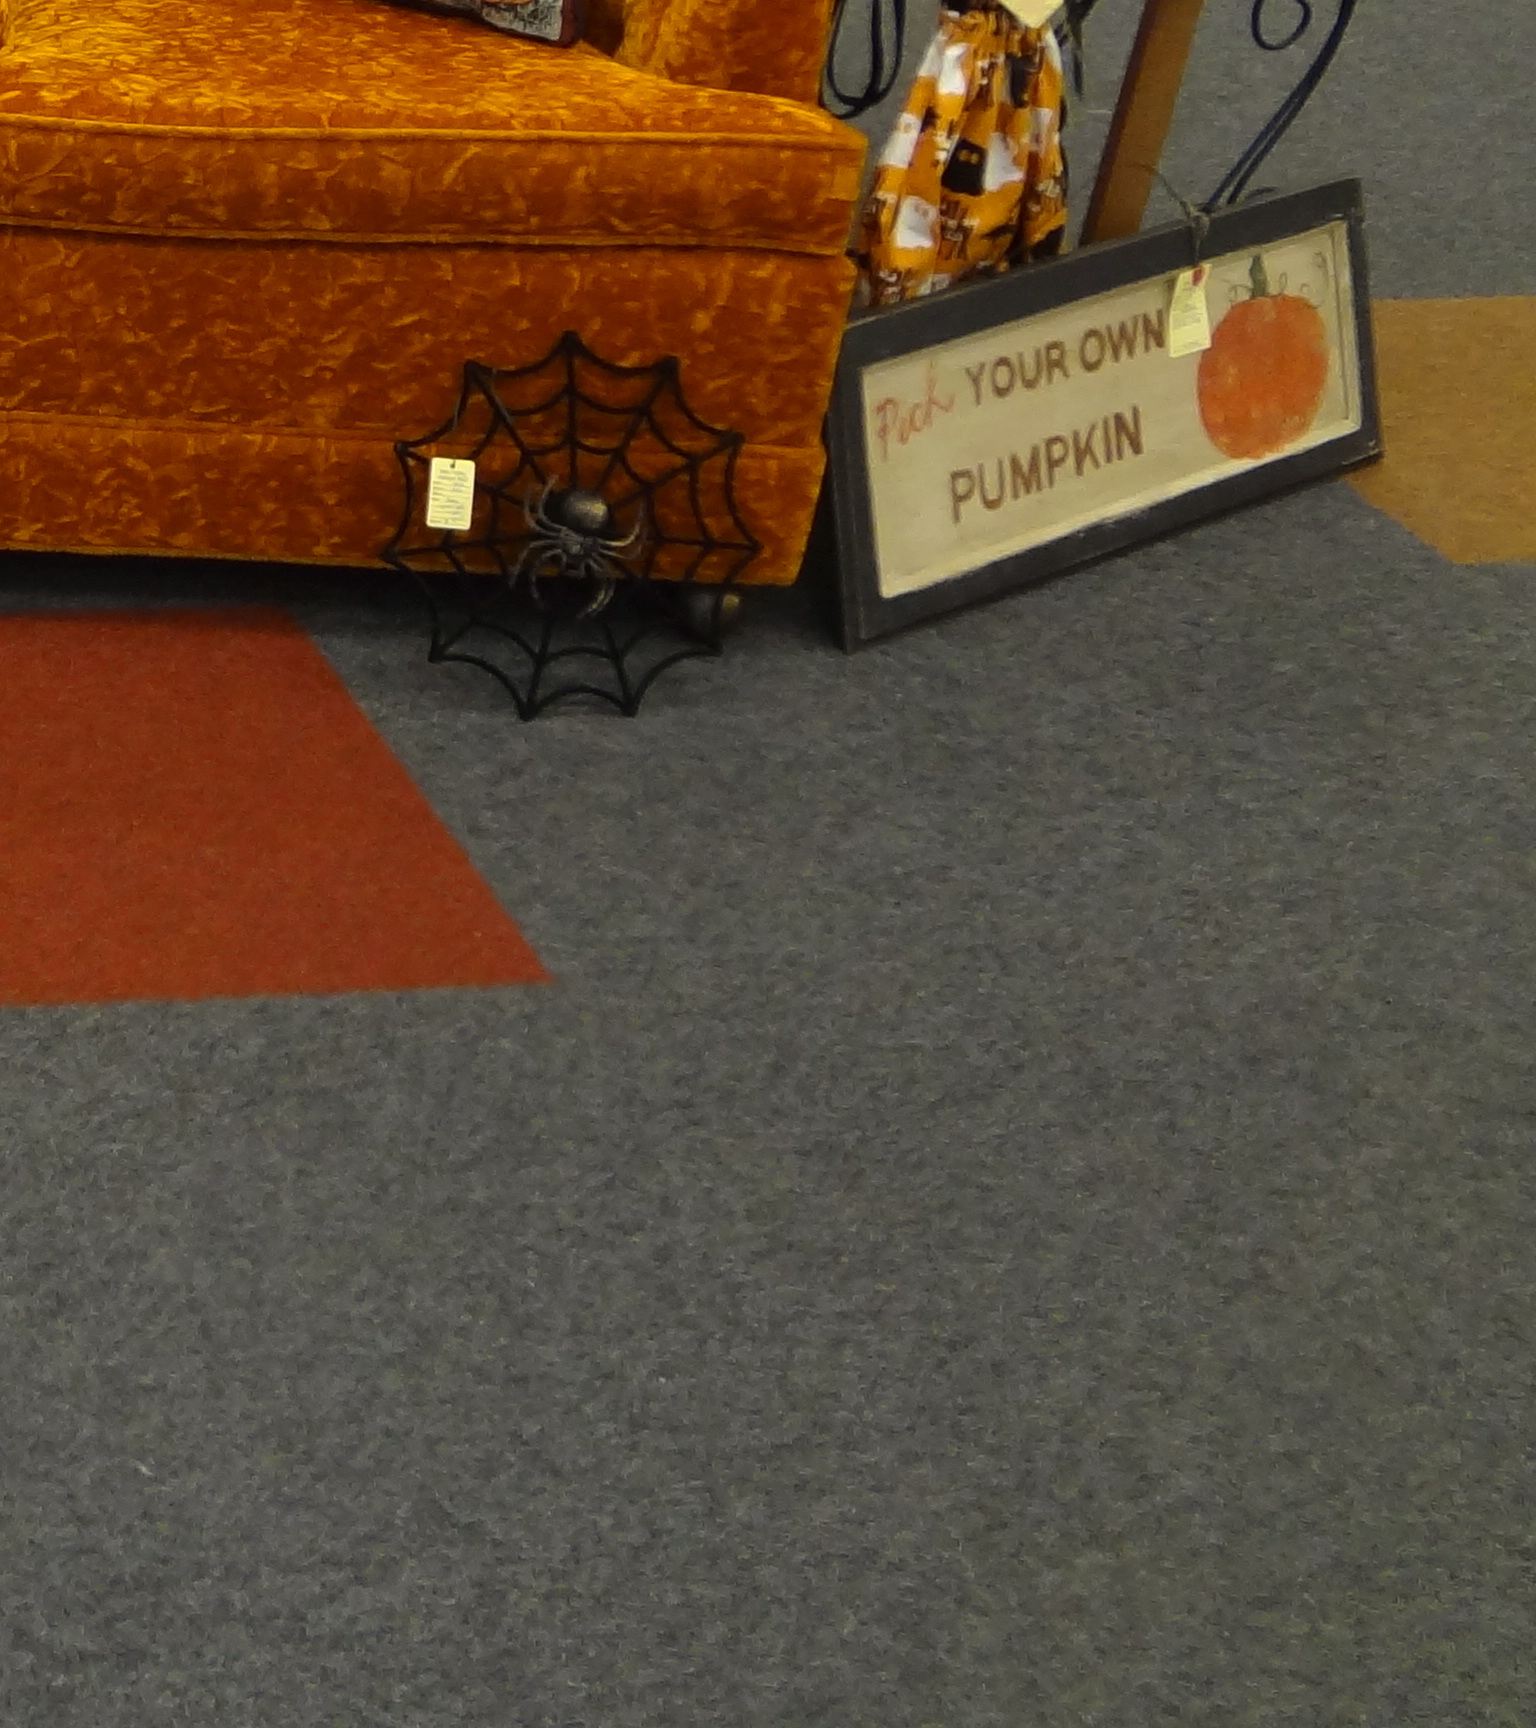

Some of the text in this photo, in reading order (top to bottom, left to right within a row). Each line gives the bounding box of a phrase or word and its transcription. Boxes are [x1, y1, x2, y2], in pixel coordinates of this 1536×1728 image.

[964, 339, 1070, 406] YOUR
[1079, 308, 1166, 372] OWN
[949, 405, 1144, 524] PUMPKIN
